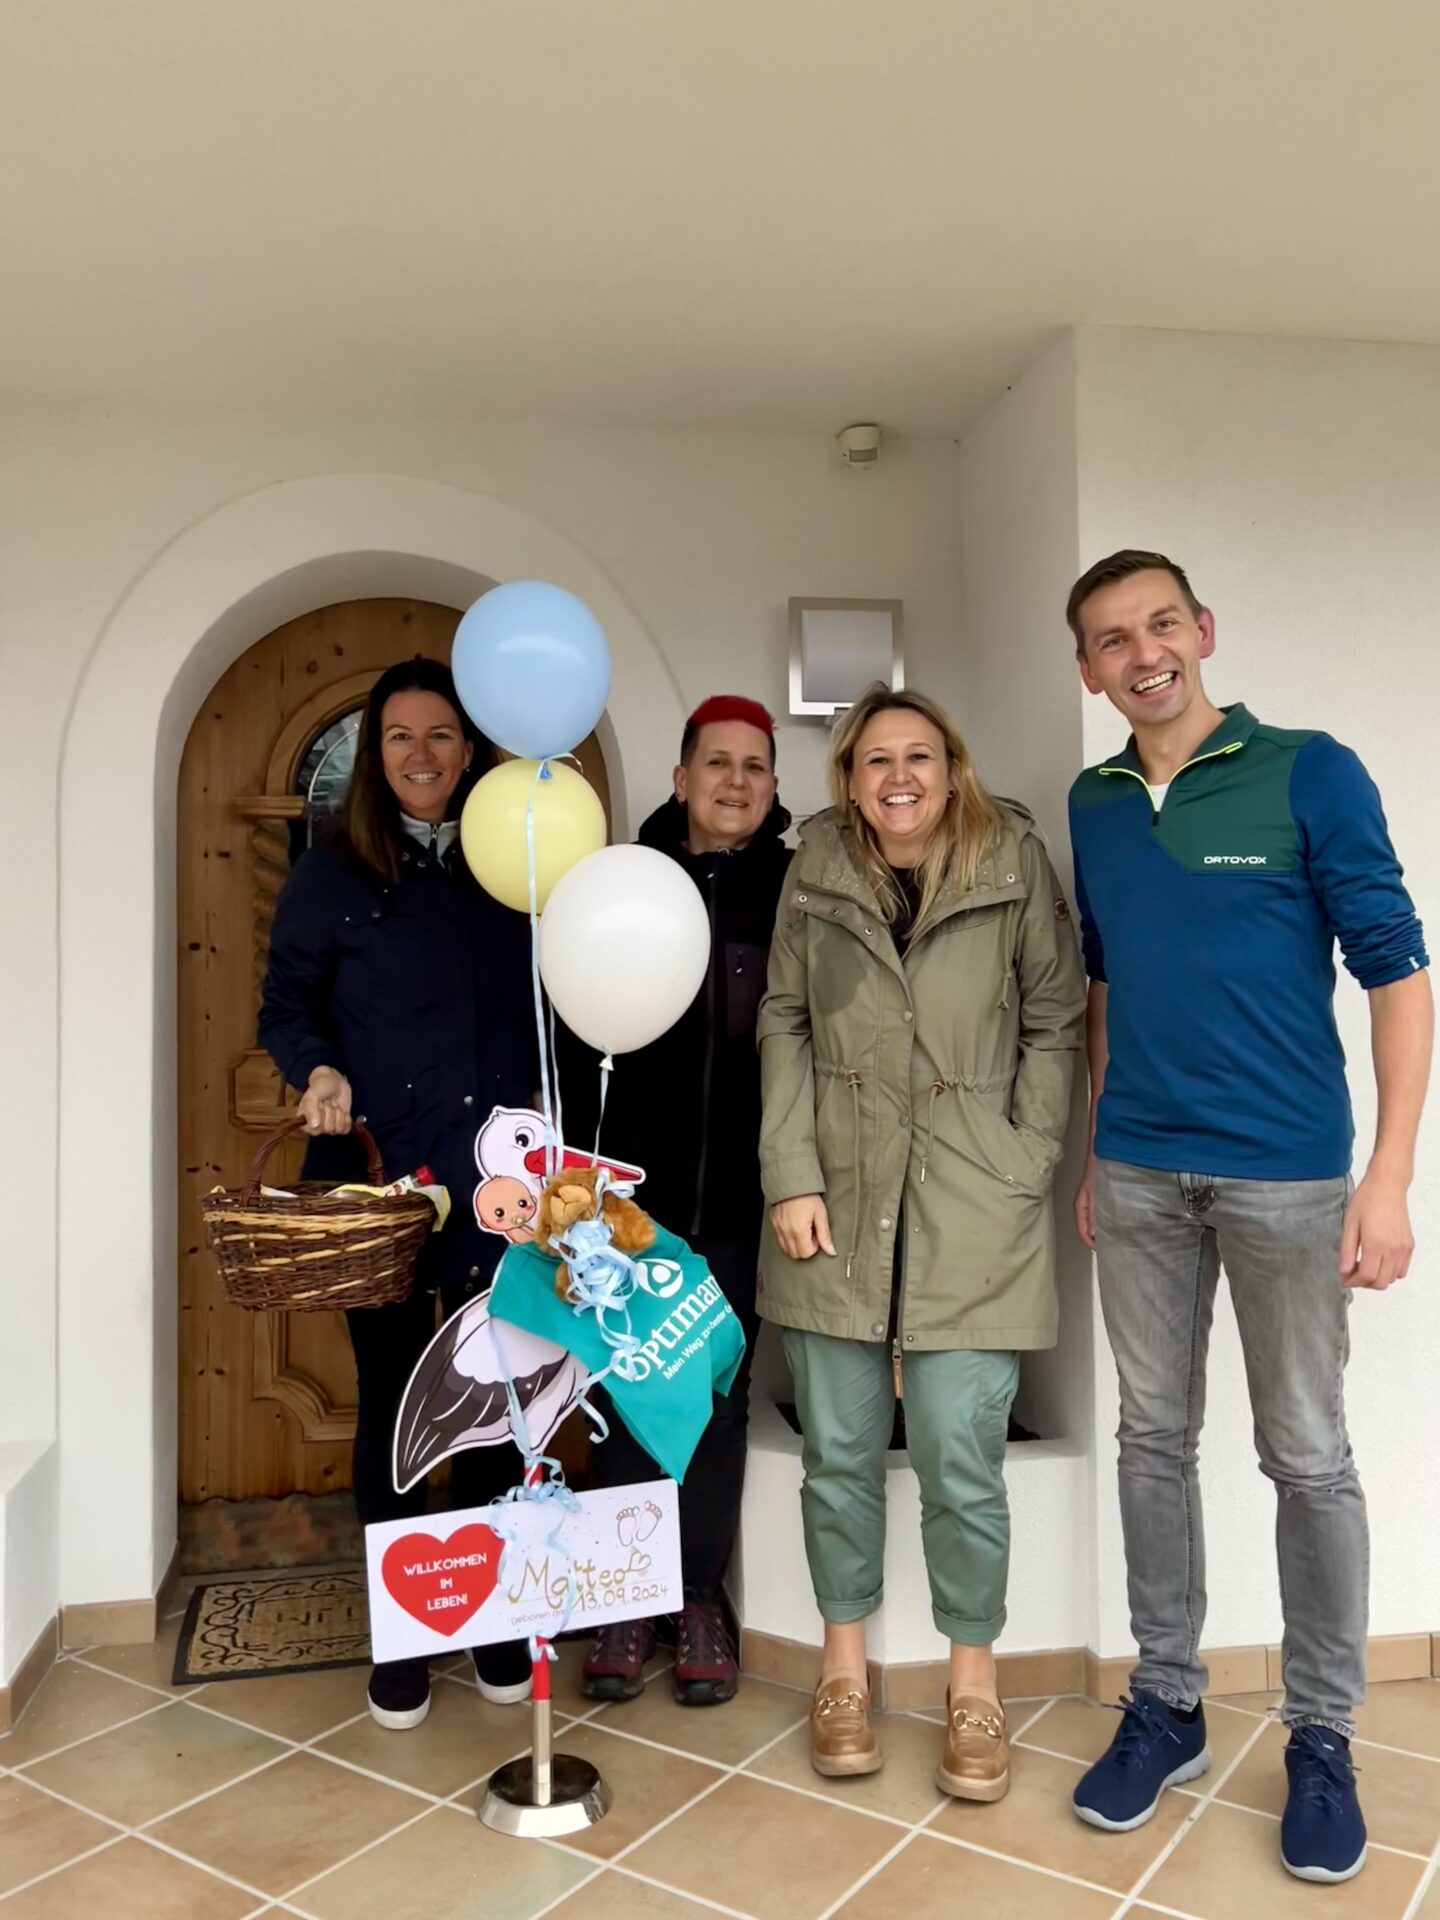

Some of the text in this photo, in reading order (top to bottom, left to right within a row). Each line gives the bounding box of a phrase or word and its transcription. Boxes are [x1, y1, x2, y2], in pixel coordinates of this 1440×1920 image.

[1203, 855, 1267, 864] ORTOVOX
[681, 1337, 705, 1358] Weg
[403, 1552, 488, 1577] WILLKOMMEN
[440, 1577, 453, 1590] IM
[427, 1592, 469, 1612] LEBEN!
[511, 1611, 551, 1626] geboren
